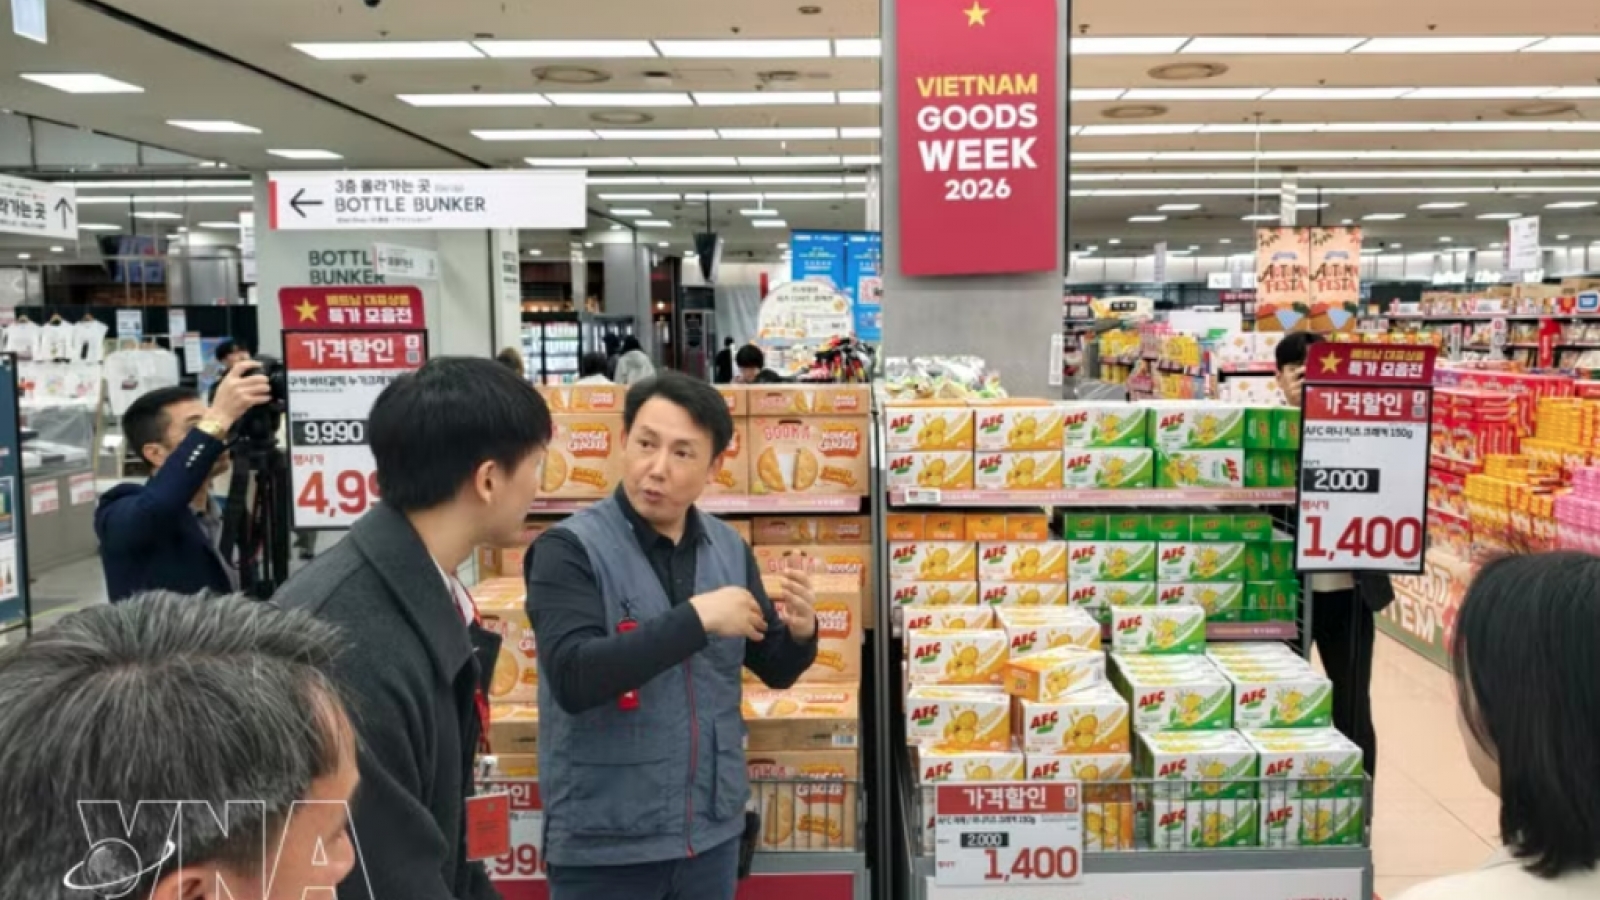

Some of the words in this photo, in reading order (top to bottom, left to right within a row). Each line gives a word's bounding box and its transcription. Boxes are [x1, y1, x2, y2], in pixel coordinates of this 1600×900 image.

[917, 73, 1038, 98] VIETNAM
[917, 103, 1038, 132] GOODS
[918, 137, 1038, 172] WEEK
[335, 179, 357, 194] 3층
[361, 179, 414, 194] 올라가는
[418, 178, 431, 194] 곳
[944, 178, 1012, 202] 2026
[34, 202, 47, 220] 곳
[335, 196, 406, 213] BOTTLE
[413, 196, 487, 213] BUNKER
[309, 250, 373, 266] BOTTL
[329, 308, 360, 323] 특가
[302, 338, 394, 364] 가격할인
[1348, 361, 1378, 377] 특가
[1320, 391, 1402, 416] 가격할인
[890, 415, 913, 429] AFC
[980, 415, 1004, 429] AFC
[1064, 411, 1087, 426] AFC
[1160, 413, 1184, 429] AFC
[304, 422, 363, 445] 9,990
[890, 455, 913, 470] AFC
[979, 454, 1002, 469] AFC
[1067, 454, 1090, 469] AFC
[1314, 470, 1368, 490] 2,000
[1303, 515, 1421, 561] 1,400
[893, 545, 916, 559] AFC
[984, 545, 1007, 559] AFC
[1072, 546, 1095, 559] AFC
[1162, 546, 1185, 561] AFC
[909, 615, 931, 628] AFC
[1118, 615, 1142, 630] AFC
[1012, 632, 1036, 647] AFC
[915, 643, 940, 658] AFC
[1139, 691, 1164, 707] AFC
[1240, 689, 1266, 704] AFC
[911, 705, 938, 720] AFC
[1031, 712, 1058, 728] AFC
[926, 762, 952, 778] AFC
[1033, 762, 1059, 778] AFC
[1159, 759, 1186, 776] AFC
[1265, 759, 1292, 775] AFC
[963, 787, 1046, 811] 가격할인
[984, 846, 1078, 882] 1,400
